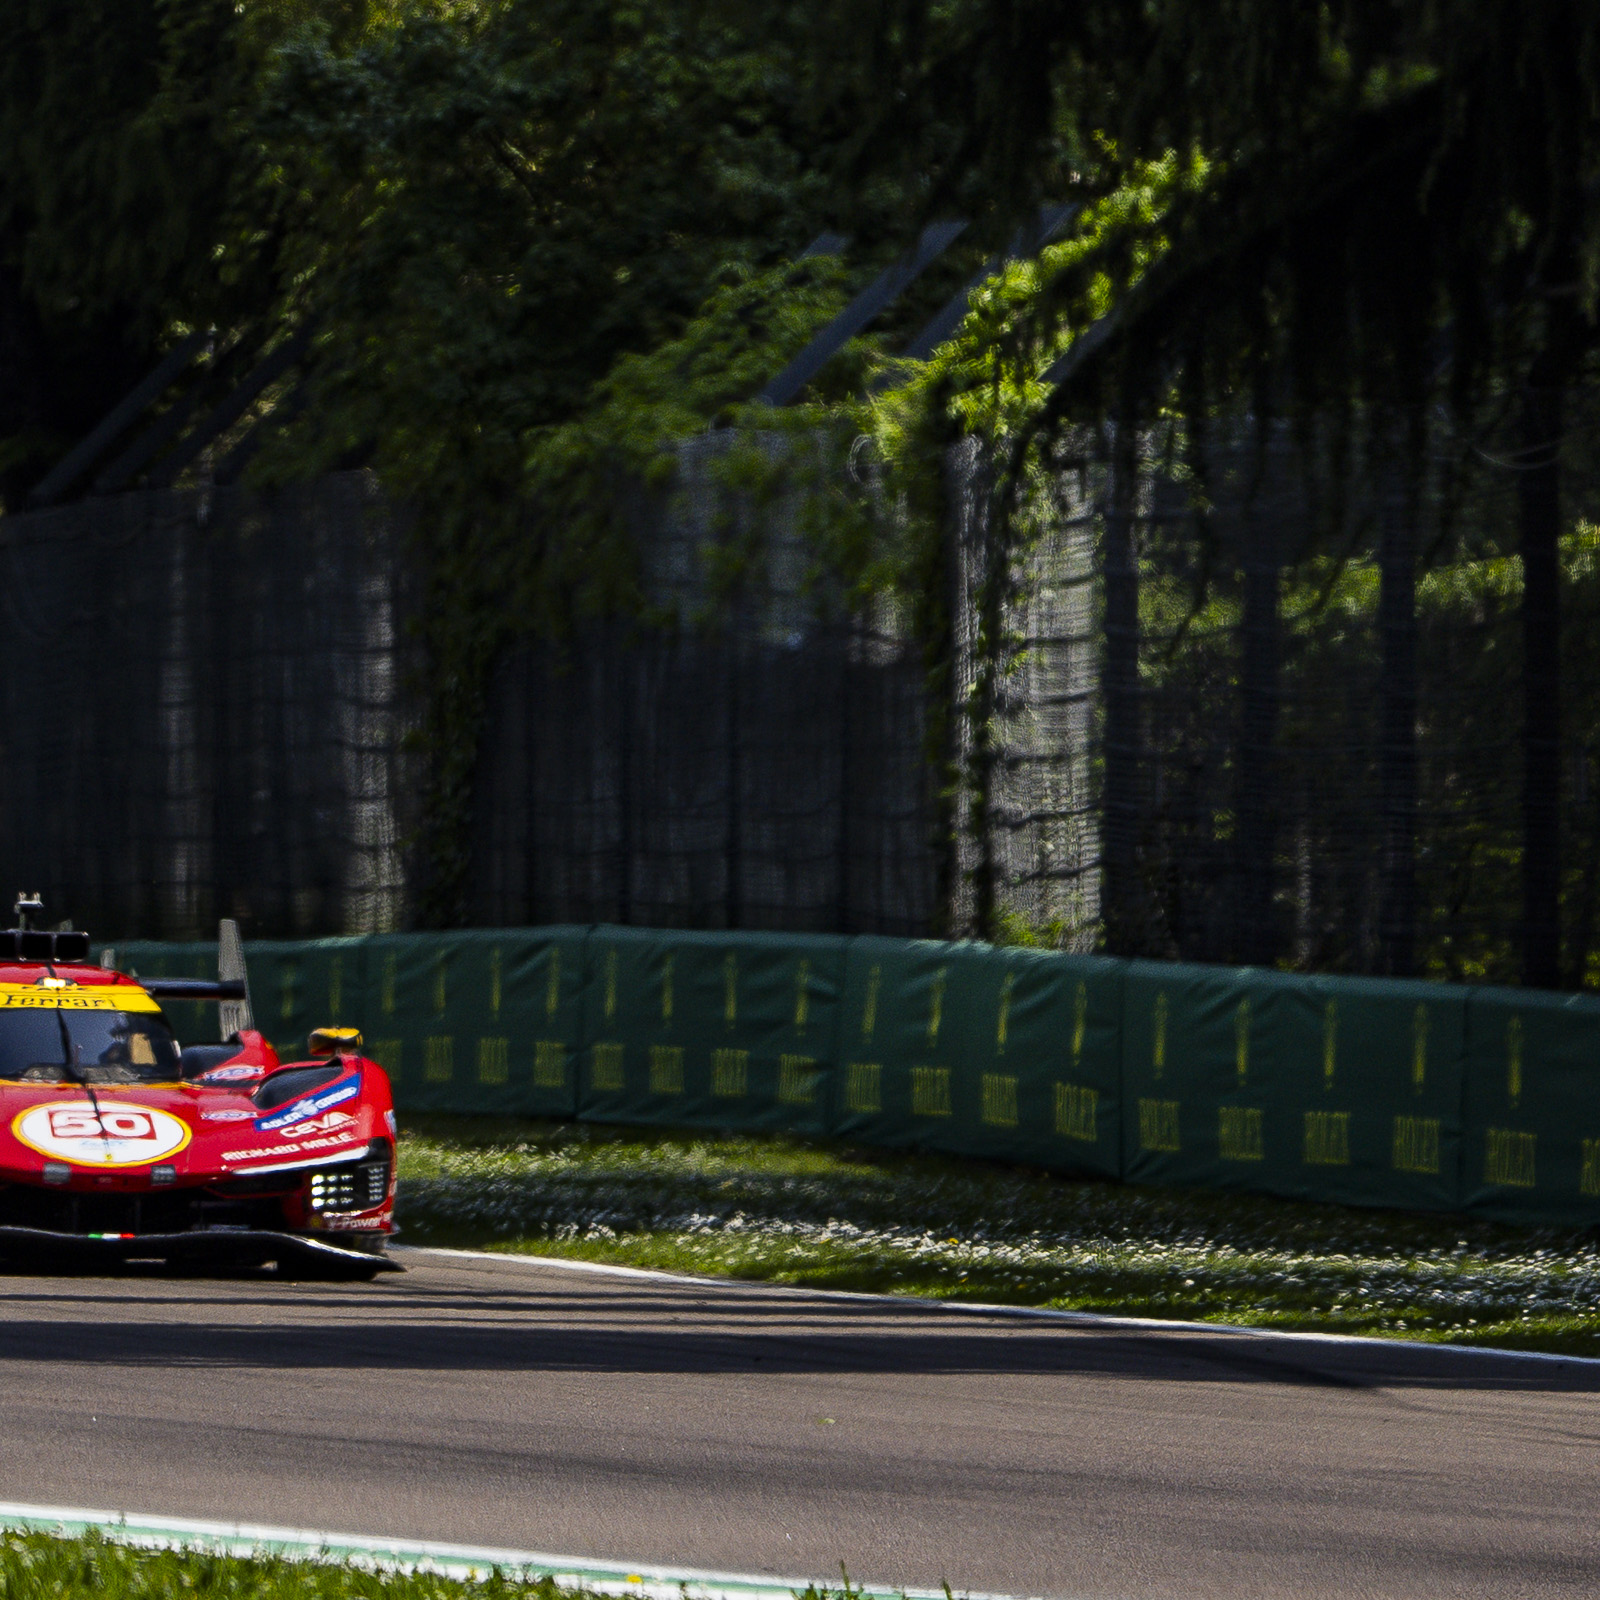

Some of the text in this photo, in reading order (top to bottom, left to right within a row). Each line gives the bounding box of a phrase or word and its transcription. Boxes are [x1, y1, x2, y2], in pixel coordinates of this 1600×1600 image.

[1, 995, 117, 1008] Ferrari
[52, 1110, 151, 1138] 50
[261, 1110, 304, 1131] ADLER
[220, 1131, 357, 1161] RICHARD MILLE
